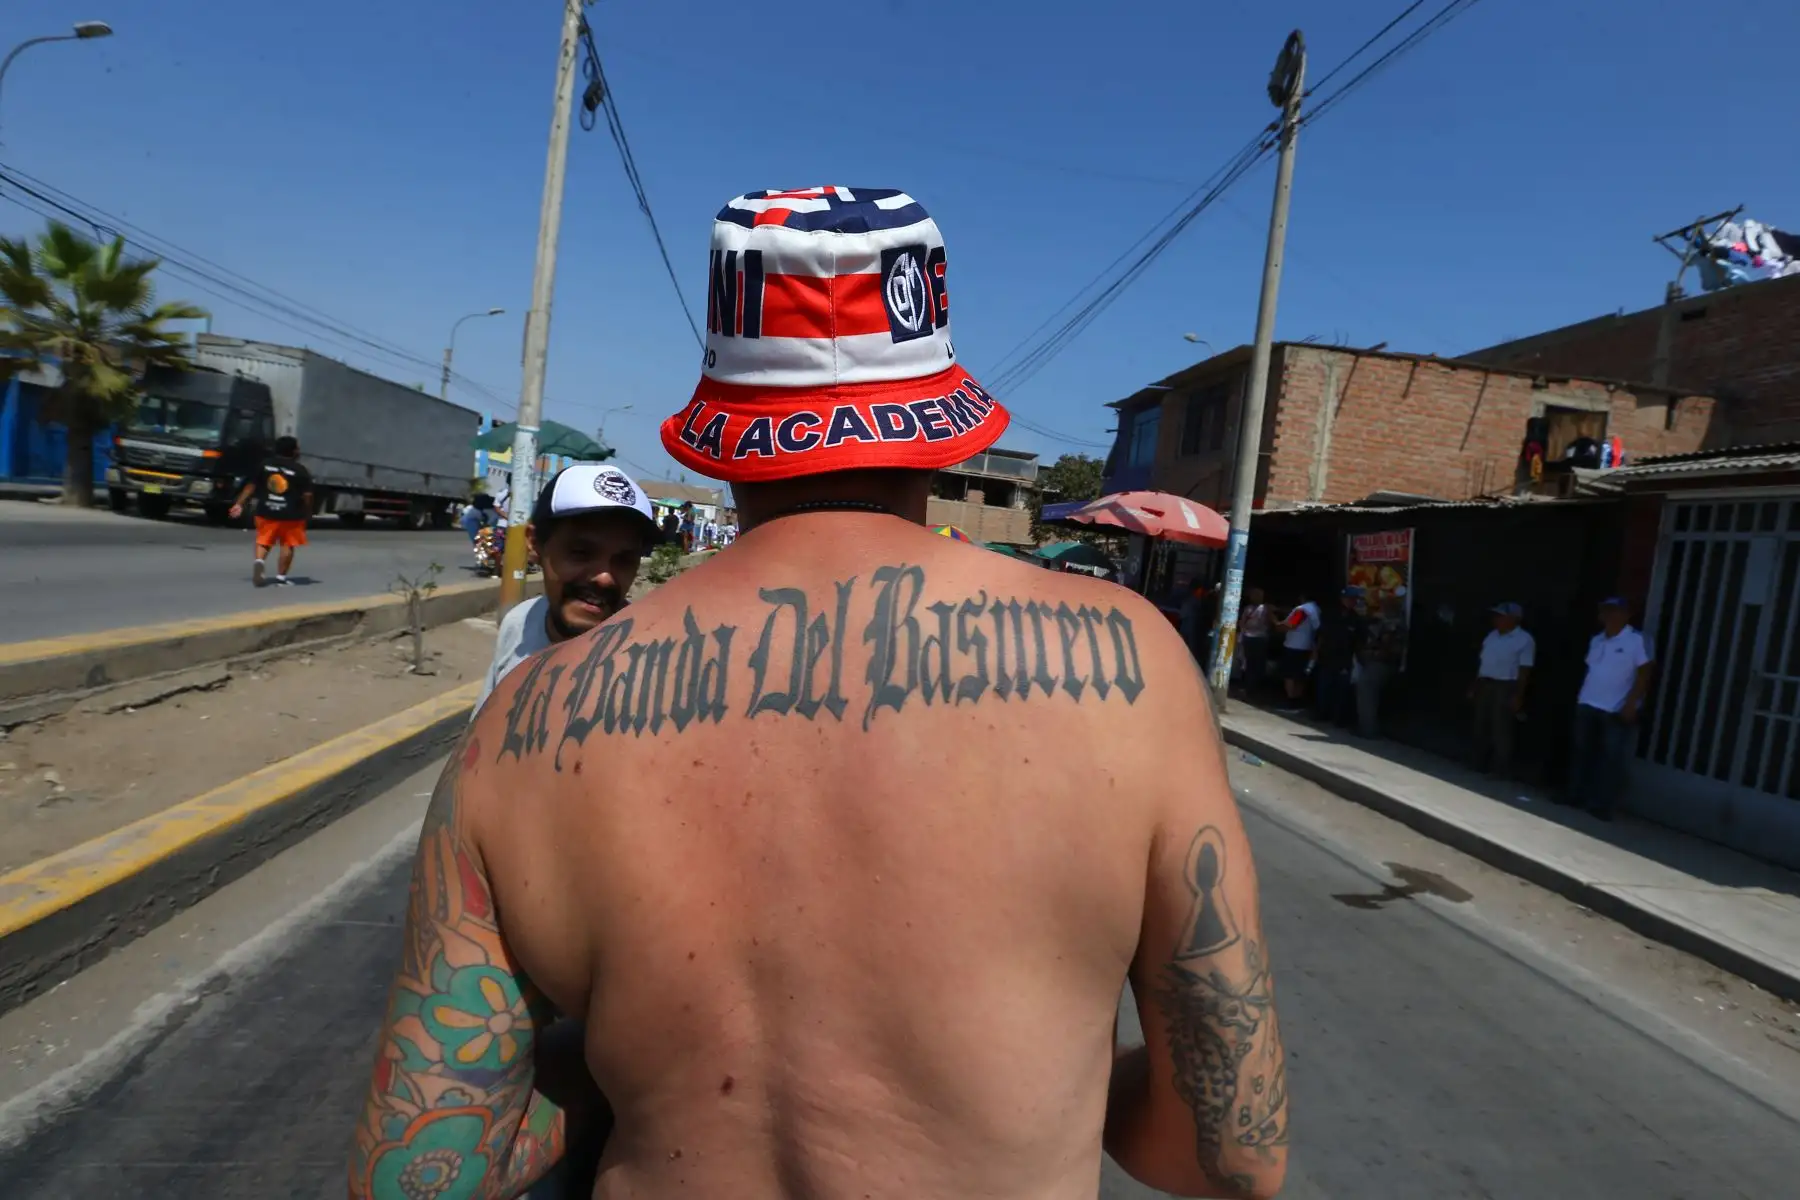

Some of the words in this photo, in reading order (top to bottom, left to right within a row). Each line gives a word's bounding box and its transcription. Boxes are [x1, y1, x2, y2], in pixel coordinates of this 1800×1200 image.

[679, 400, 729, 459] LA
[732, 377, 996, 460] ACADEMIA
[496, 647, 568, 764] La
[554, 604, 738, 772] Banda
[745, 575, 858, 721] Del
[863, 562, 1146, 732] Basurero
